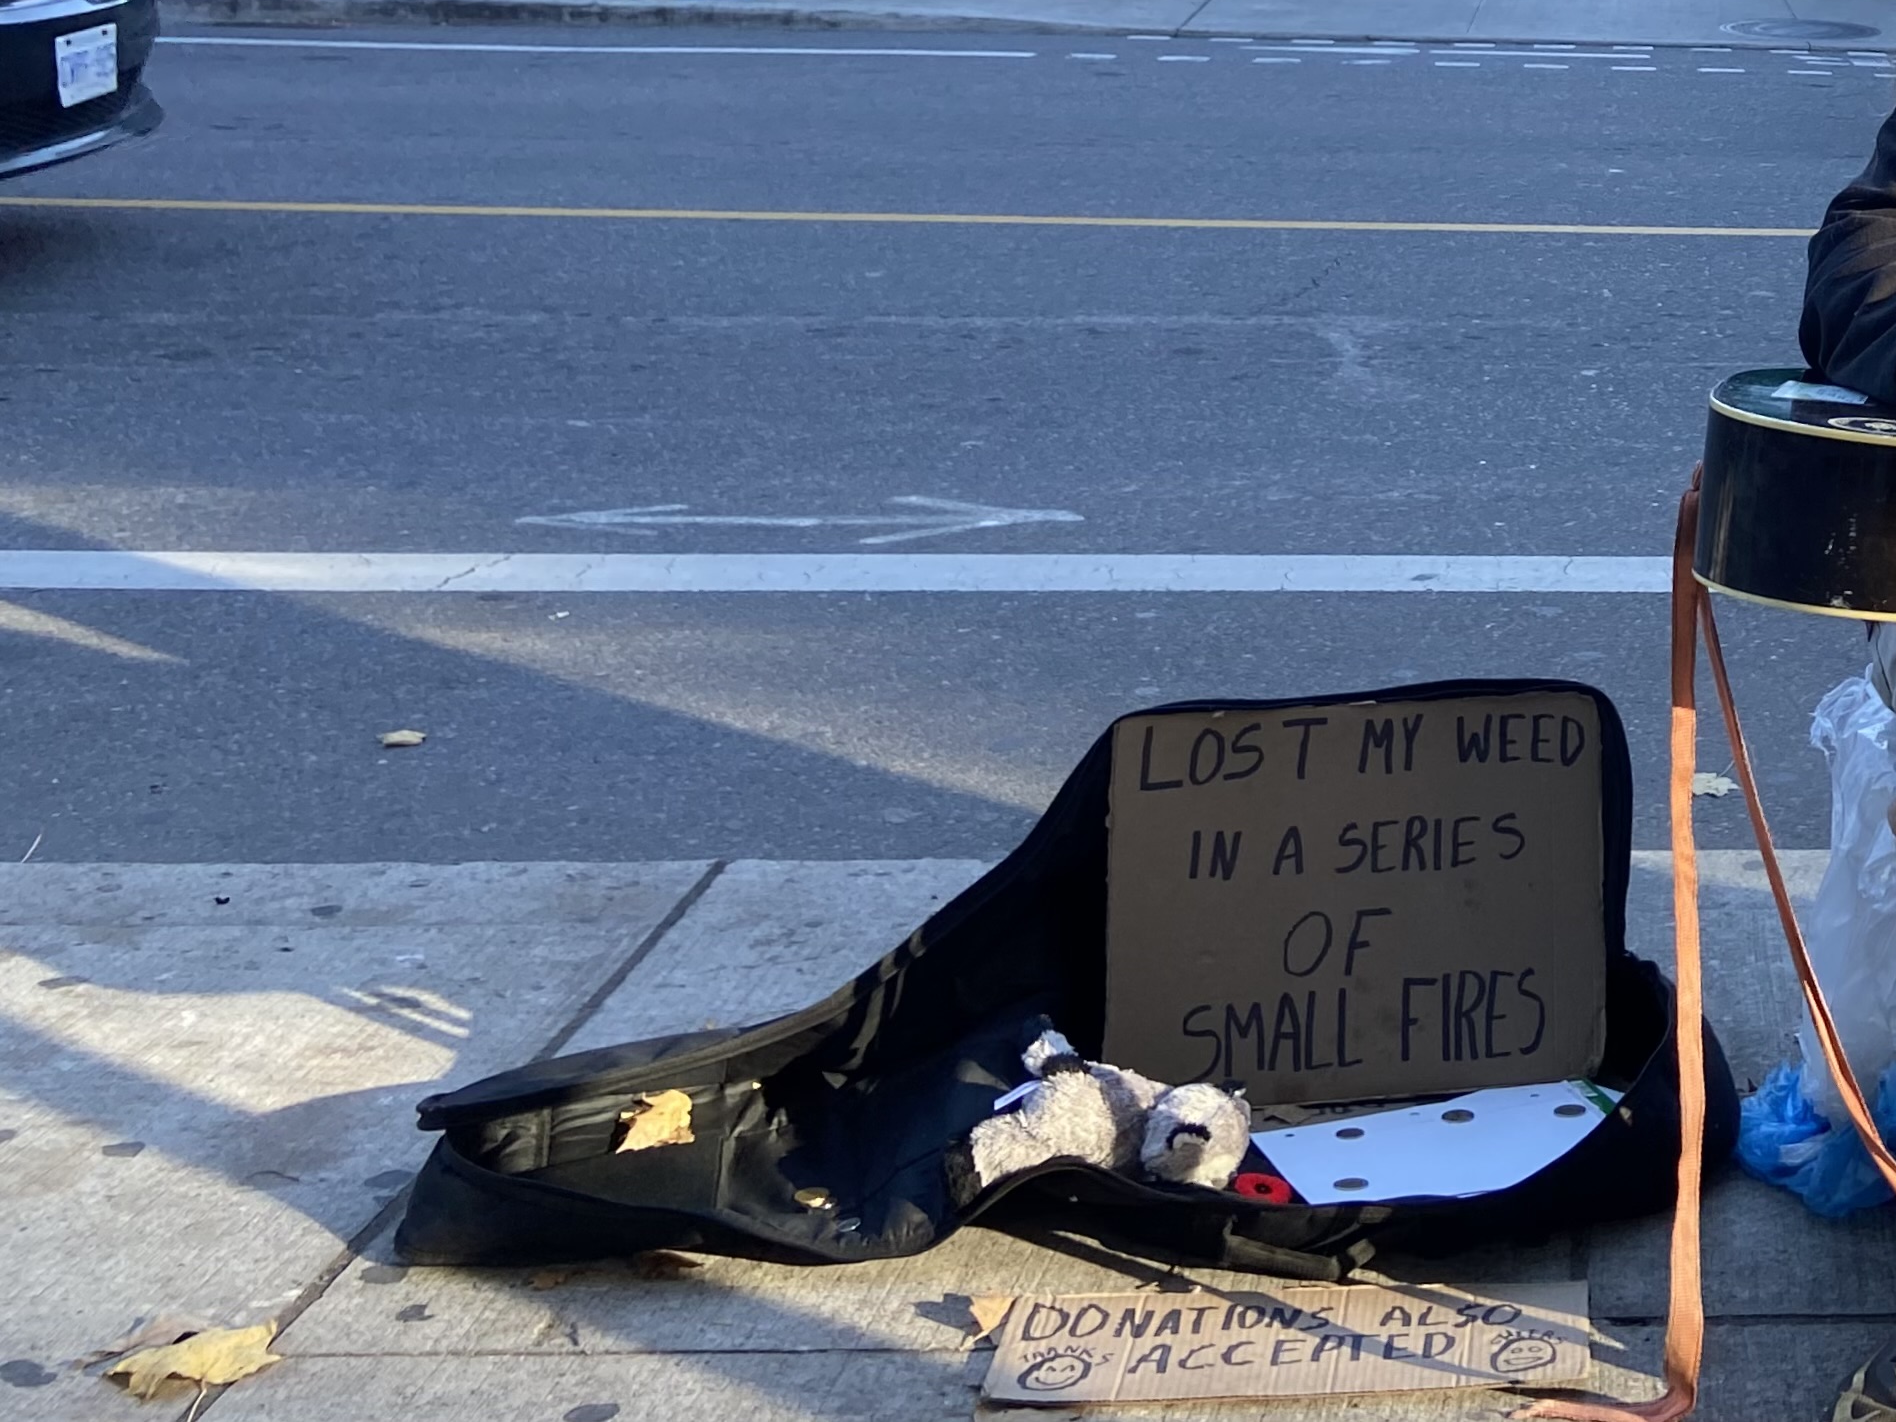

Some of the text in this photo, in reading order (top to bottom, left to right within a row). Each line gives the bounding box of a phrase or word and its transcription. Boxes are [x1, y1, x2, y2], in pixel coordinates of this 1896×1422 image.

[1140, 713, 1585, 791] LOST MY WEED
[1189, 813, 1525, 881] IN A SERIES
[1283, 907, 1392, 977] OF
[1182, 968, 1546, 1080] SMALL FIRES
[1019, 1345, 1116, 1367] THANKS
[1020, 1302, 1523, 1342] DONATIONS ALSO
[1127, 1331, 1456, 1375] ACCEPTED
